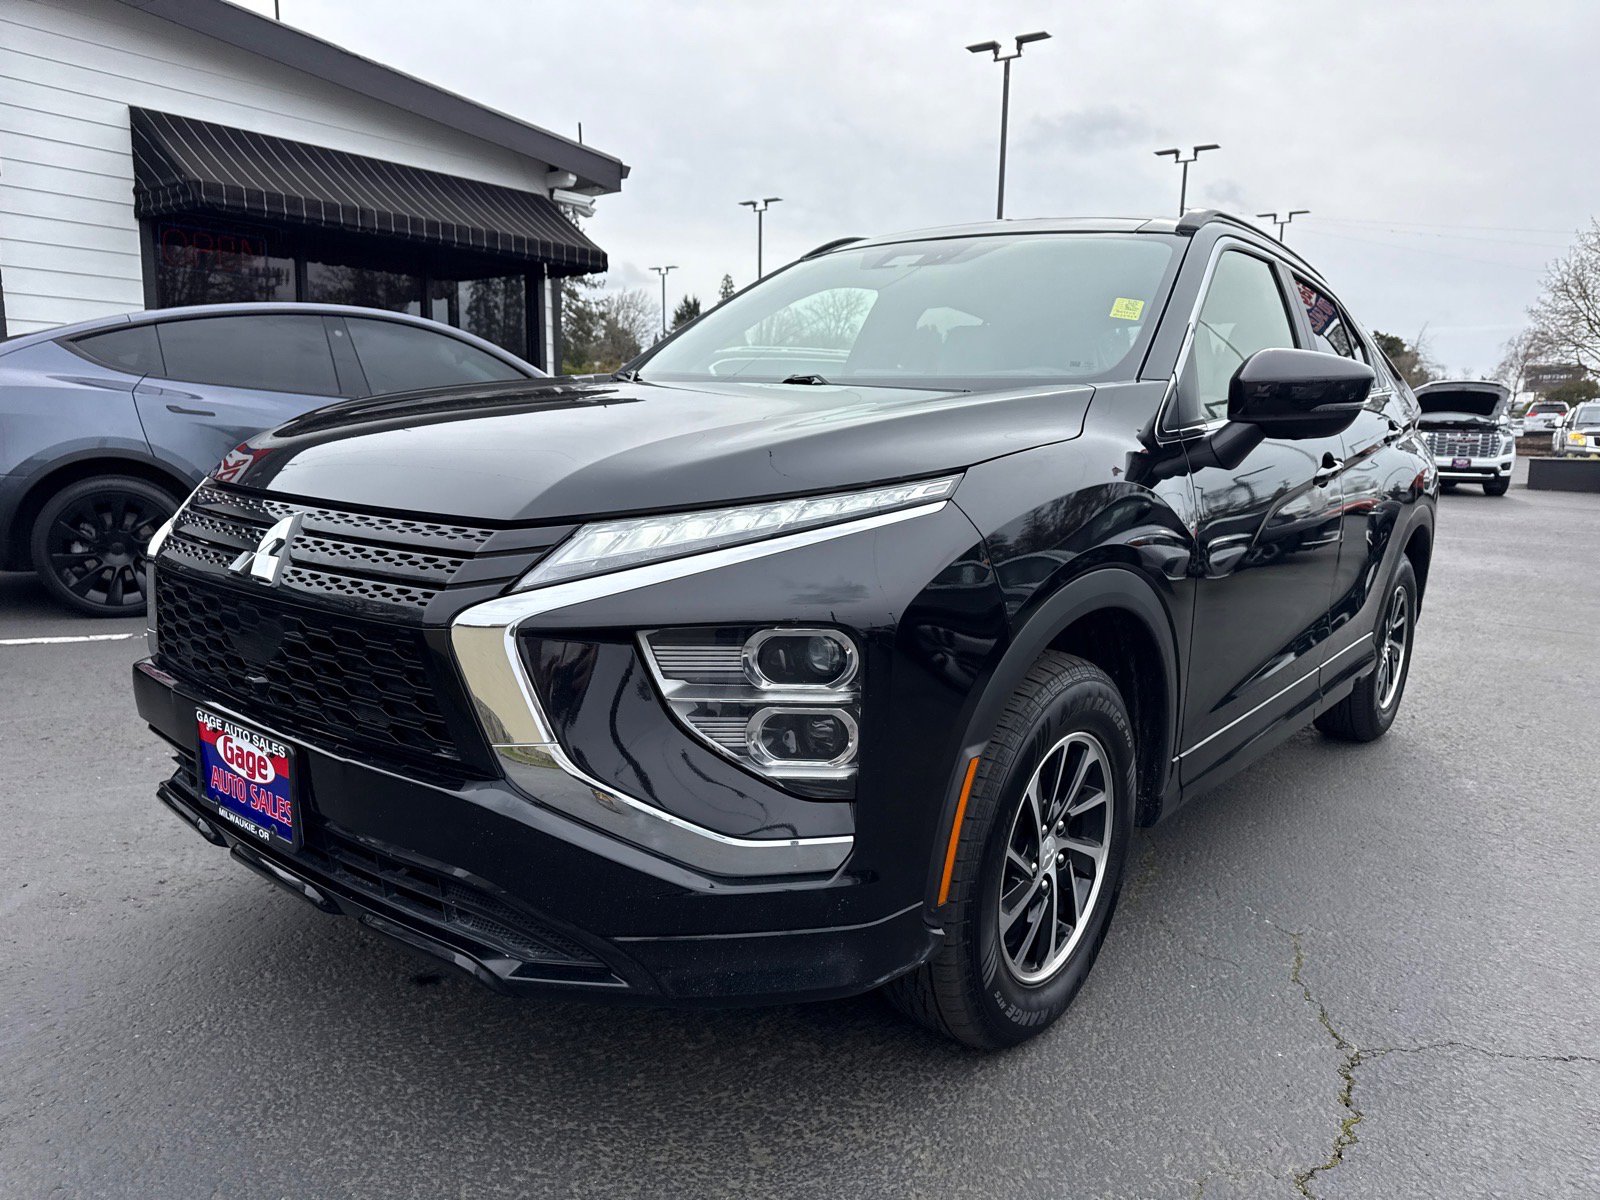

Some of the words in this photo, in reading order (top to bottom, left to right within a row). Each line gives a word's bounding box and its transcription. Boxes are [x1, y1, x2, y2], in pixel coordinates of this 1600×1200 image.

[162, 228, 263, 273] OPEN
[196, 710, 223, 732] GAGE
[224, 722, 250, 743] AUTO
[252, 734, 286, 758] SALES
[1093, 697, 1126, 730] RANGE
[222, 734, 268, 781] Gage
[210, 765, 247, 804] AUTO
[249, 783, 292, 827] SALES
[258, 829, 270, 842] OR
[1005, 1004, 1049, 1026] RANGE
